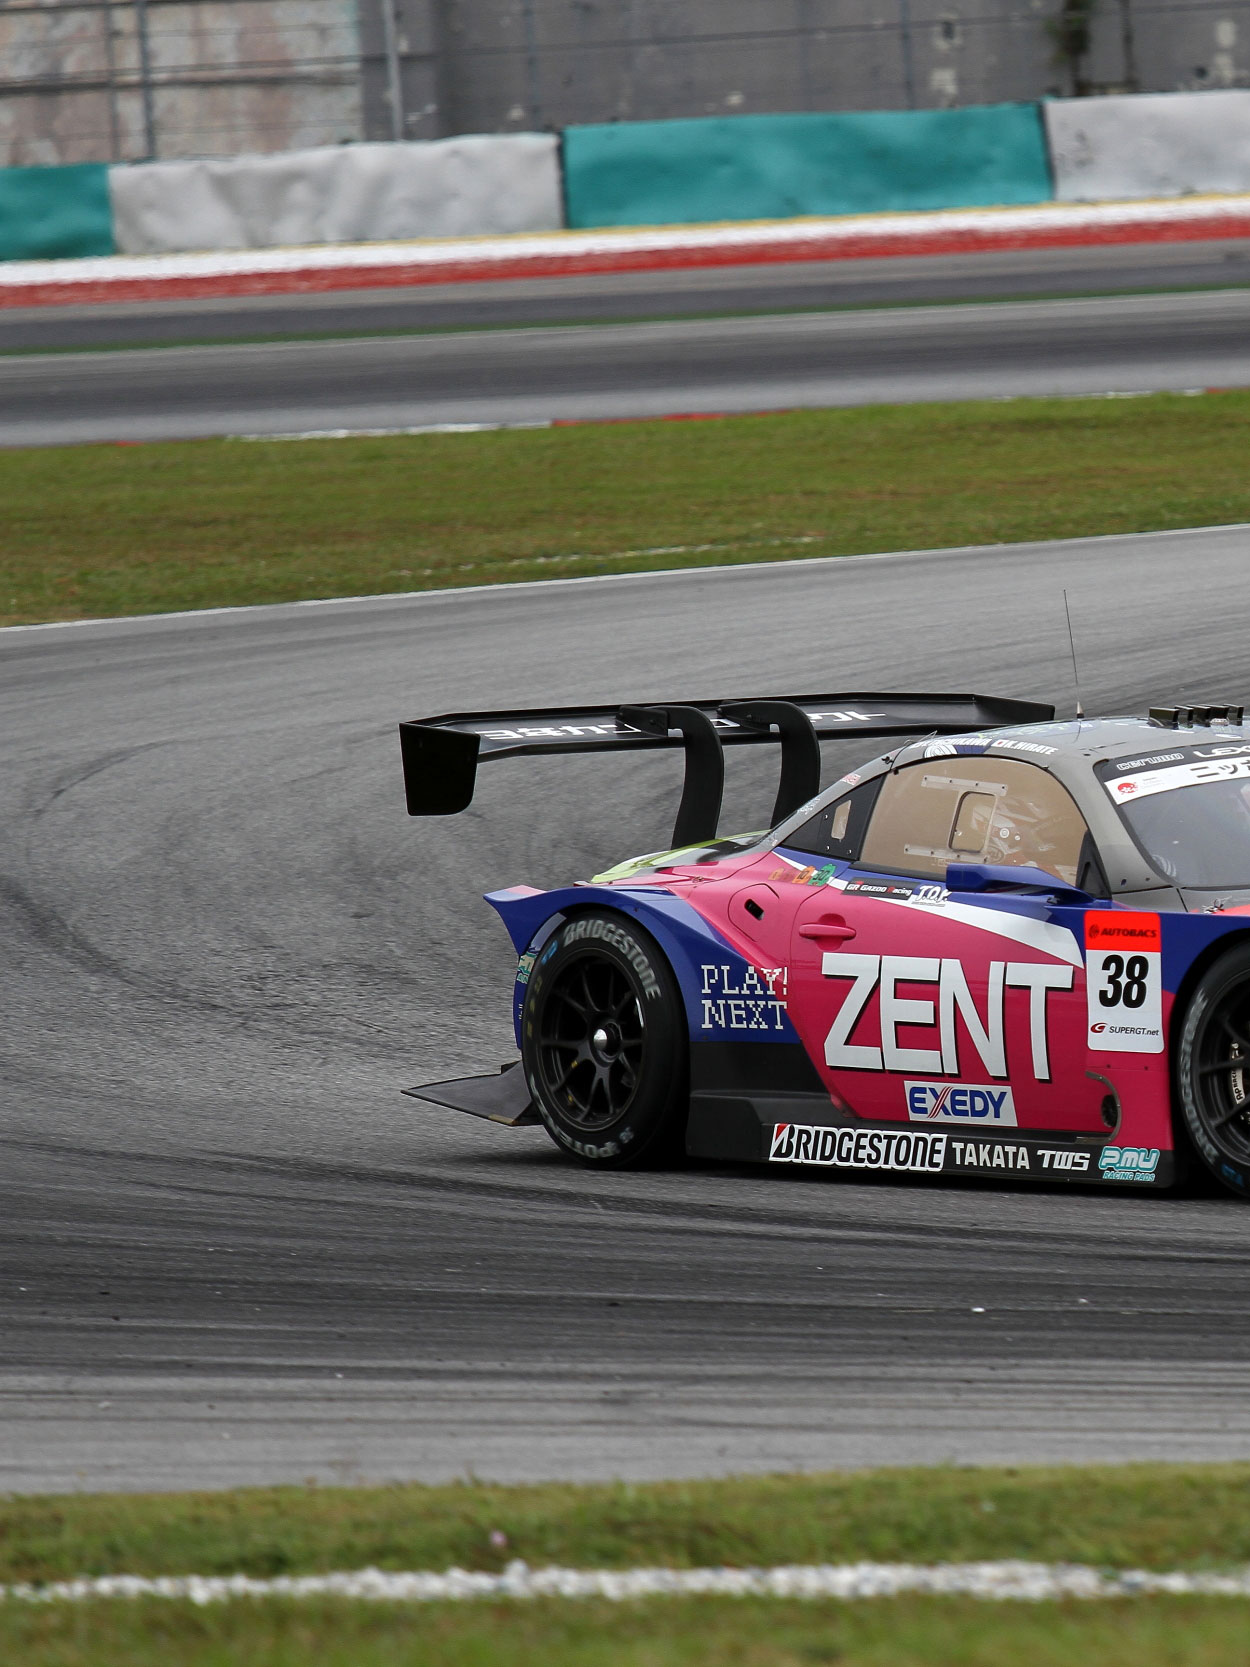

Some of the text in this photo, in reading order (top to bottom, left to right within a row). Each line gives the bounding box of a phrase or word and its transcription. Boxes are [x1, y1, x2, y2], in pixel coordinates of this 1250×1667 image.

[847, 883, 913, 896] GR GAZOO Racing
[1101, 927, 1157, 938] AUTOBACS
[563, 919, 662, 1000] BRIDGESTONE
[701, 965, 788, 996] PLAY!
[1098, 954, 1150, 1009] 38
[701, 999, 788, 1030] NEXT
[821, 952, 1074, 1081] ZENT
[1109, 1026, 1160, 1037] SUPERGT.net
[909, 1086, 1008, 1119] EXEDY
[771, 1124, 946, 1171] BRIDGESTONE
[952, 1141, 1031, 1170] TAKATA
[1036, 1149, 1091, 1171] TWS
[1102, 1171, 1156, 1182] RACING PADS
